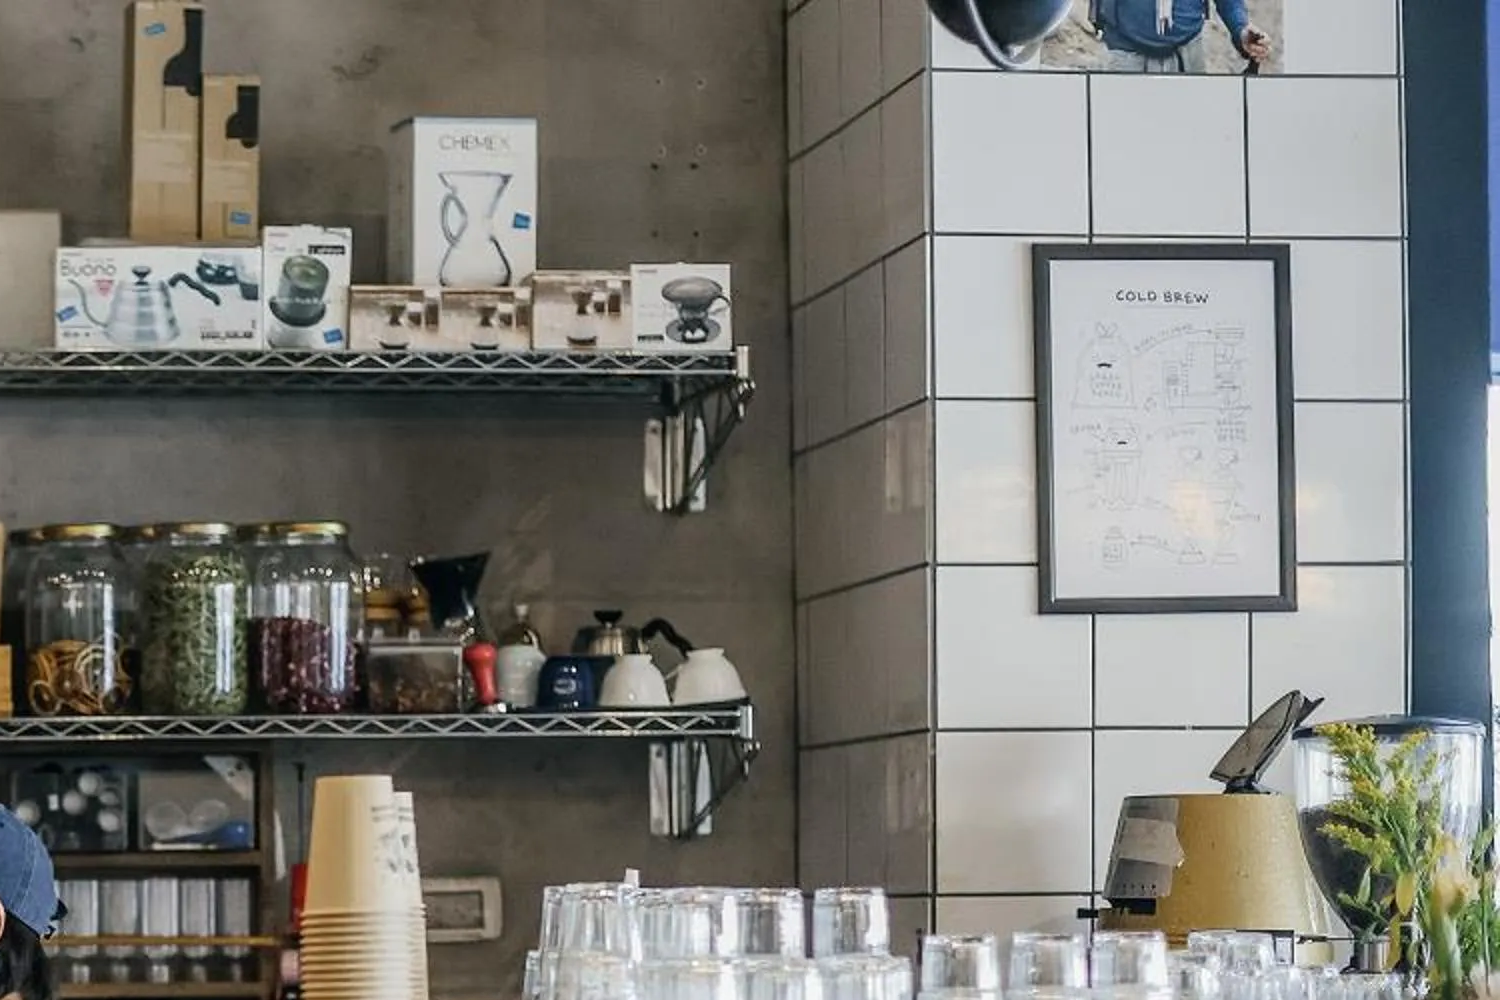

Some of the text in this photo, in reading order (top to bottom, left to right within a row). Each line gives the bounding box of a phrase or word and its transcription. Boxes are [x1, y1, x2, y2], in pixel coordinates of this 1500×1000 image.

[438, 133, 511, 152] CHEMEX
[1115, 288, 1210, 305] COLD BREW
